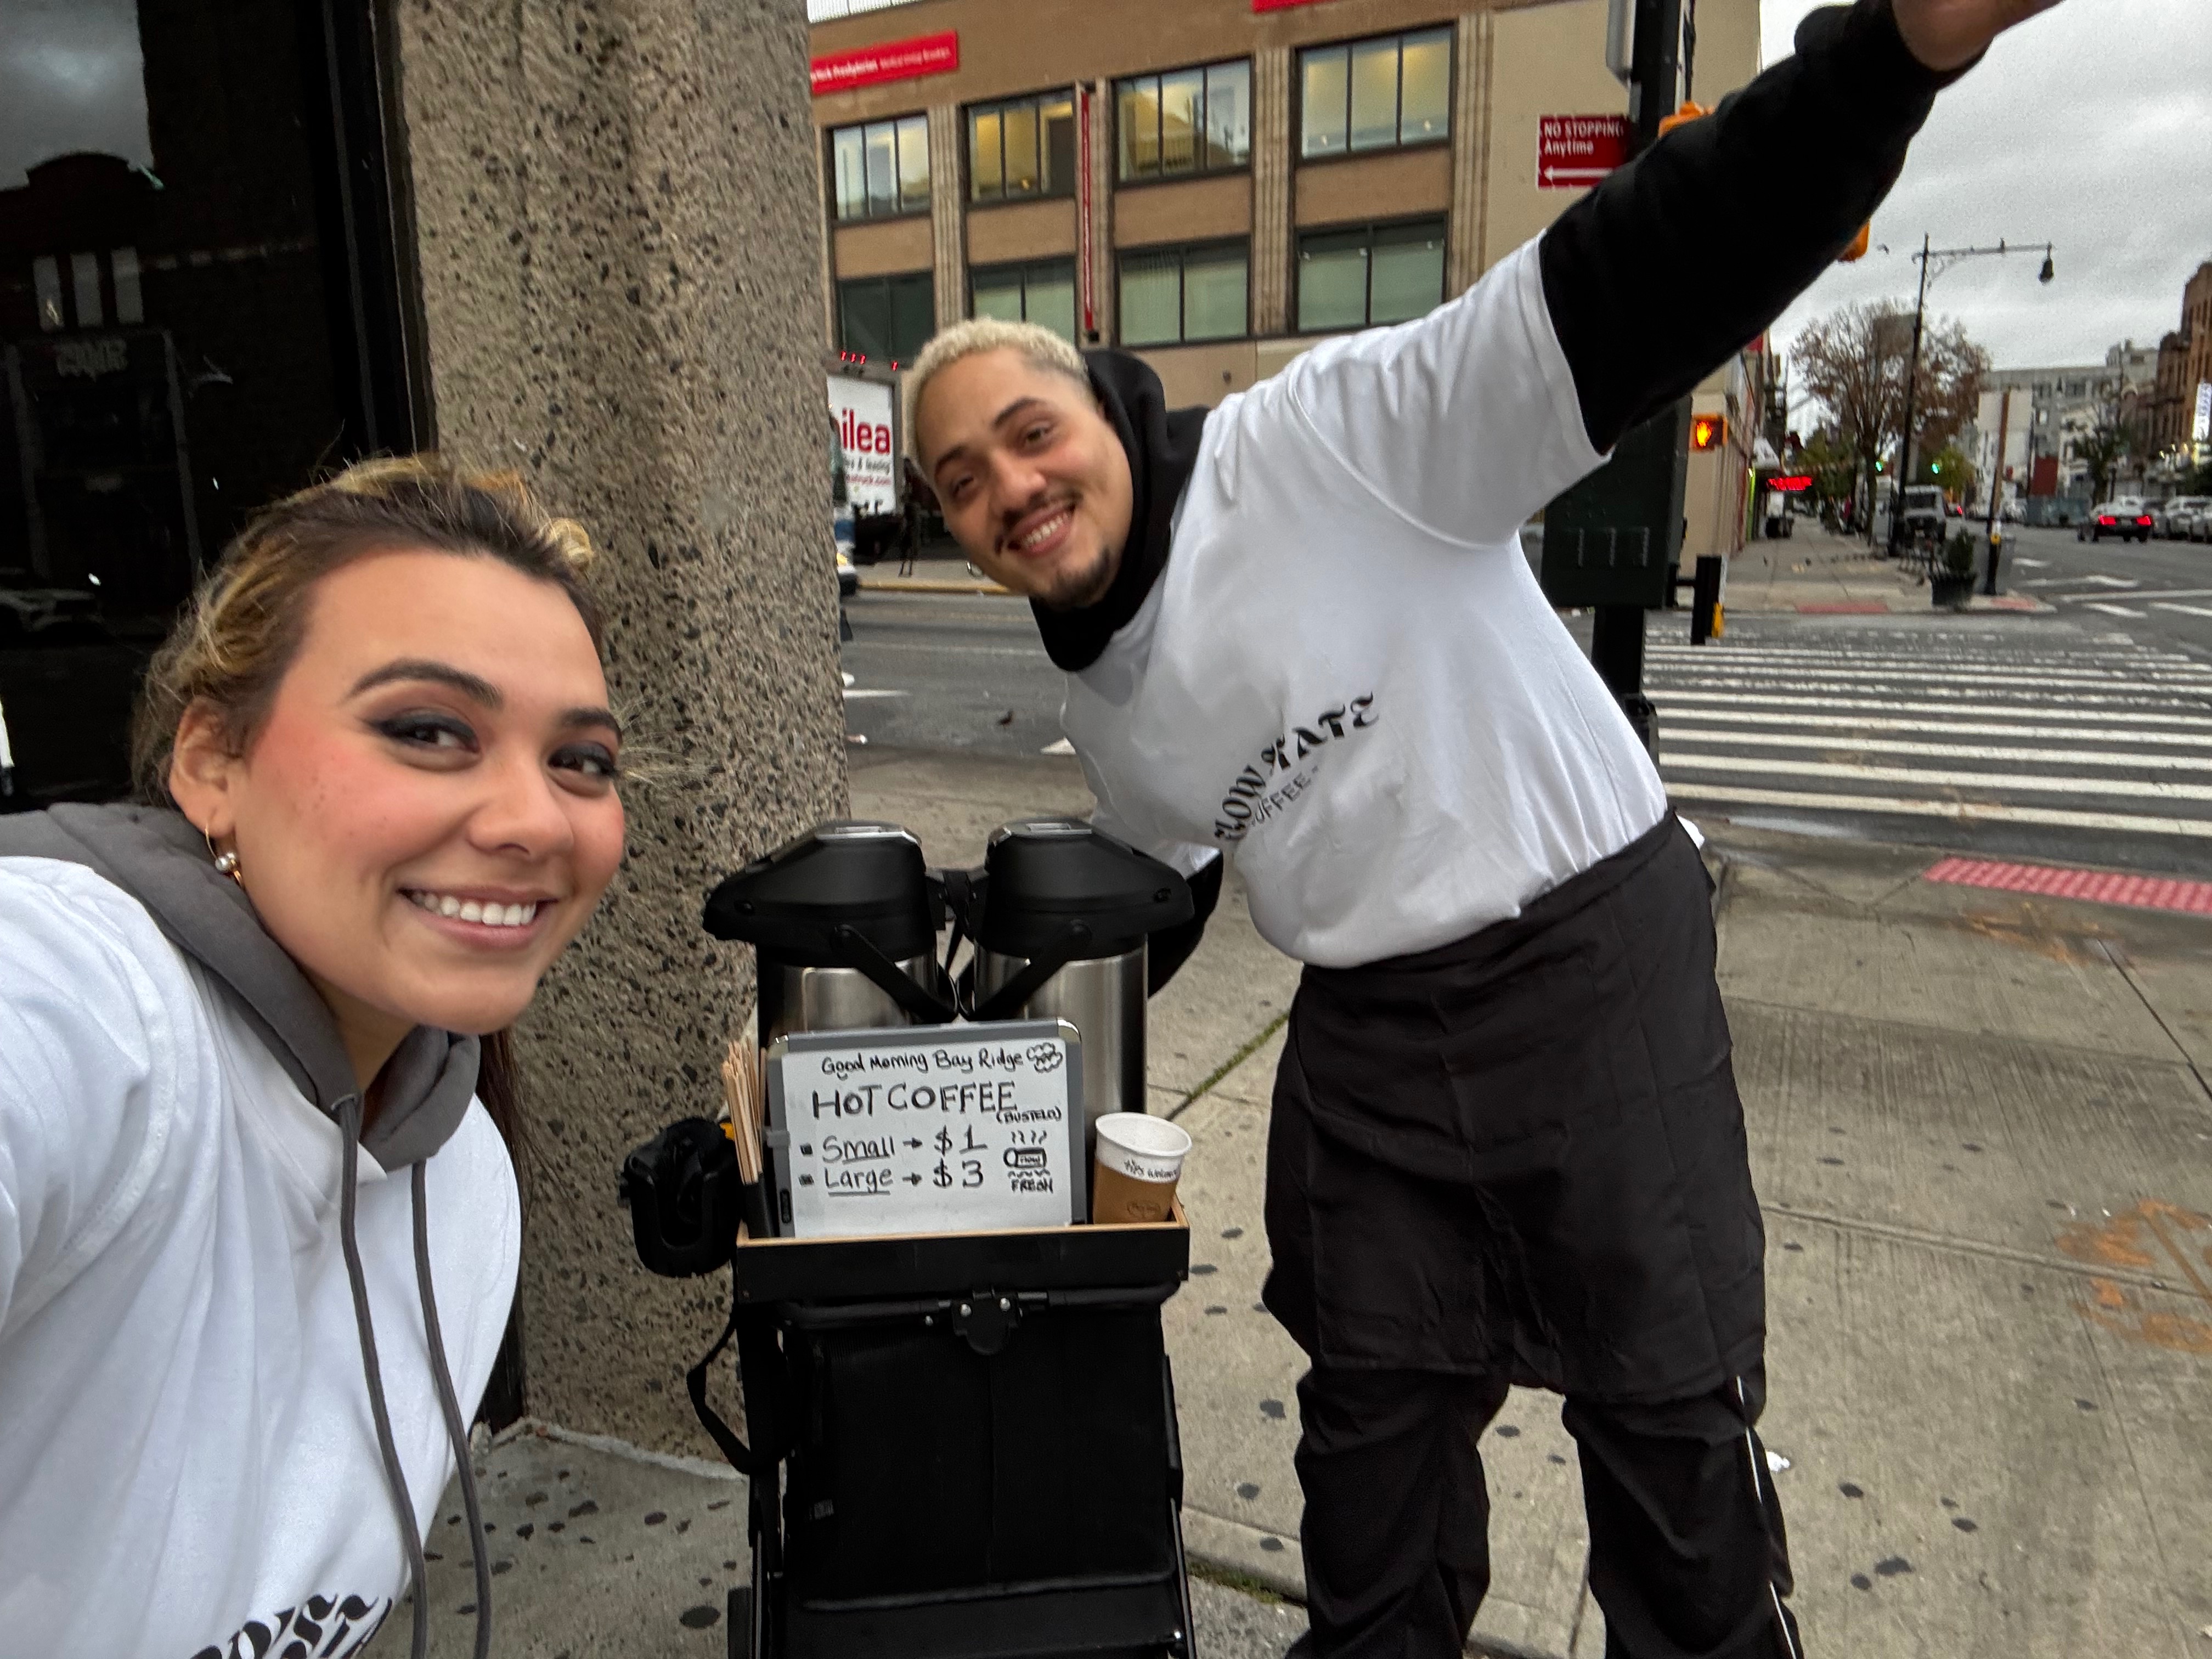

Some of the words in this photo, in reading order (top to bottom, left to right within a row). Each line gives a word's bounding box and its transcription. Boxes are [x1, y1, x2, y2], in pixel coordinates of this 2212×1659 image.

[1544, 121, 1561, 138] NO
[1565, 121, 1624, 138] STOPPING
[1544, 139, 1594, 159] Anytime
[1251, 772, 1312, 825] OFFEE
[822, 1052, 865, 1079] Good
[870, 1053, 929, 1074] Morning
[934, 1048, 973, 1074] Bay
[978, 1047, 1024, 1073] Ridge
[812, 1084, 882, 1120] HOT
[887, 1081, 1018, 1114] COFFEE
[822, 1135, 895, 1164] Small
[823, 1167, 894, 1194] Large
